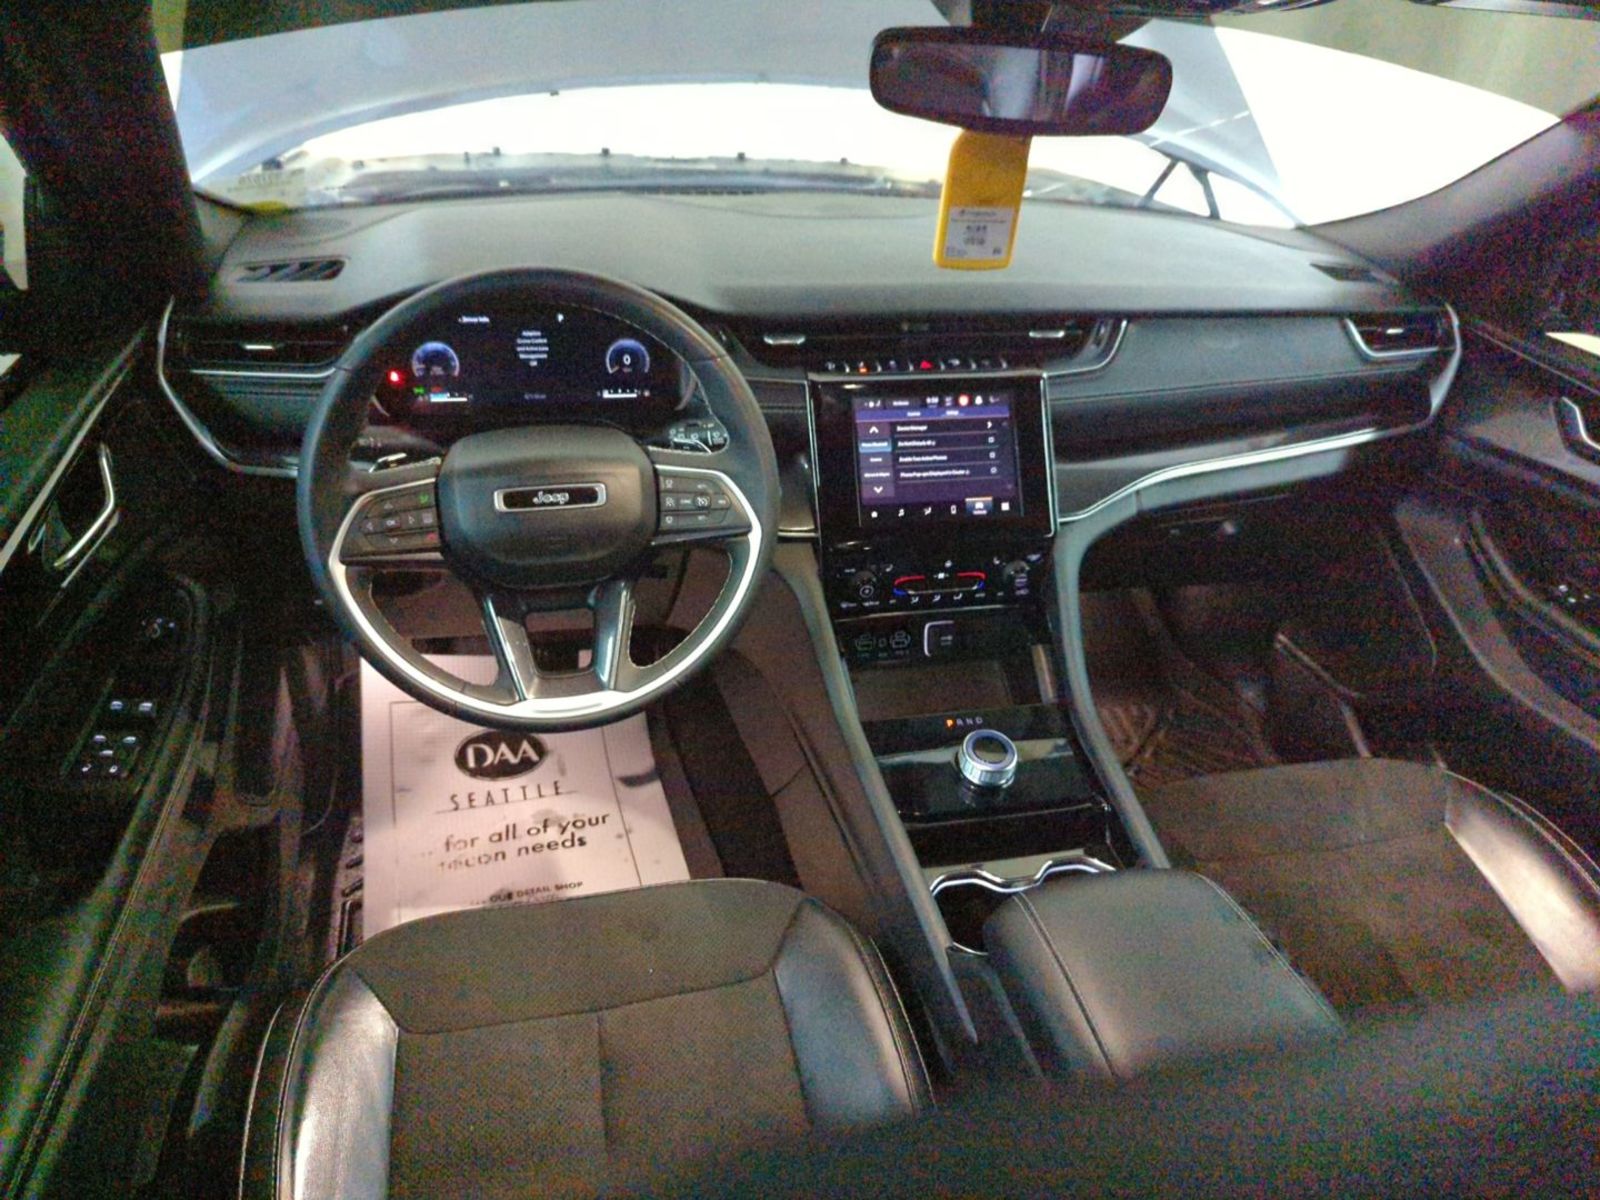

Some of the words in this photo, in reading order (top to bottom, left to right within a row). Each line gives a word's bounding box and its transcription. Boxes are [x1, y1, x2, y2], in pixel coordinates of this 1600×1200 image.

[623, 354, 631, 365] 0
[532, 491, 569, 505] Jeep
[466, 739, 540, 769] DAA
[450, 780, 562, 811] SEATTLE
[489, 823, 517, 844] all
[527, 817, 552, 837] of
[558, 813, 611, 835] your
[517, 832, 588, 857] needs
[516, 885, 551, 898] DETAIL
[554, 881, 583, 892] SHOP
